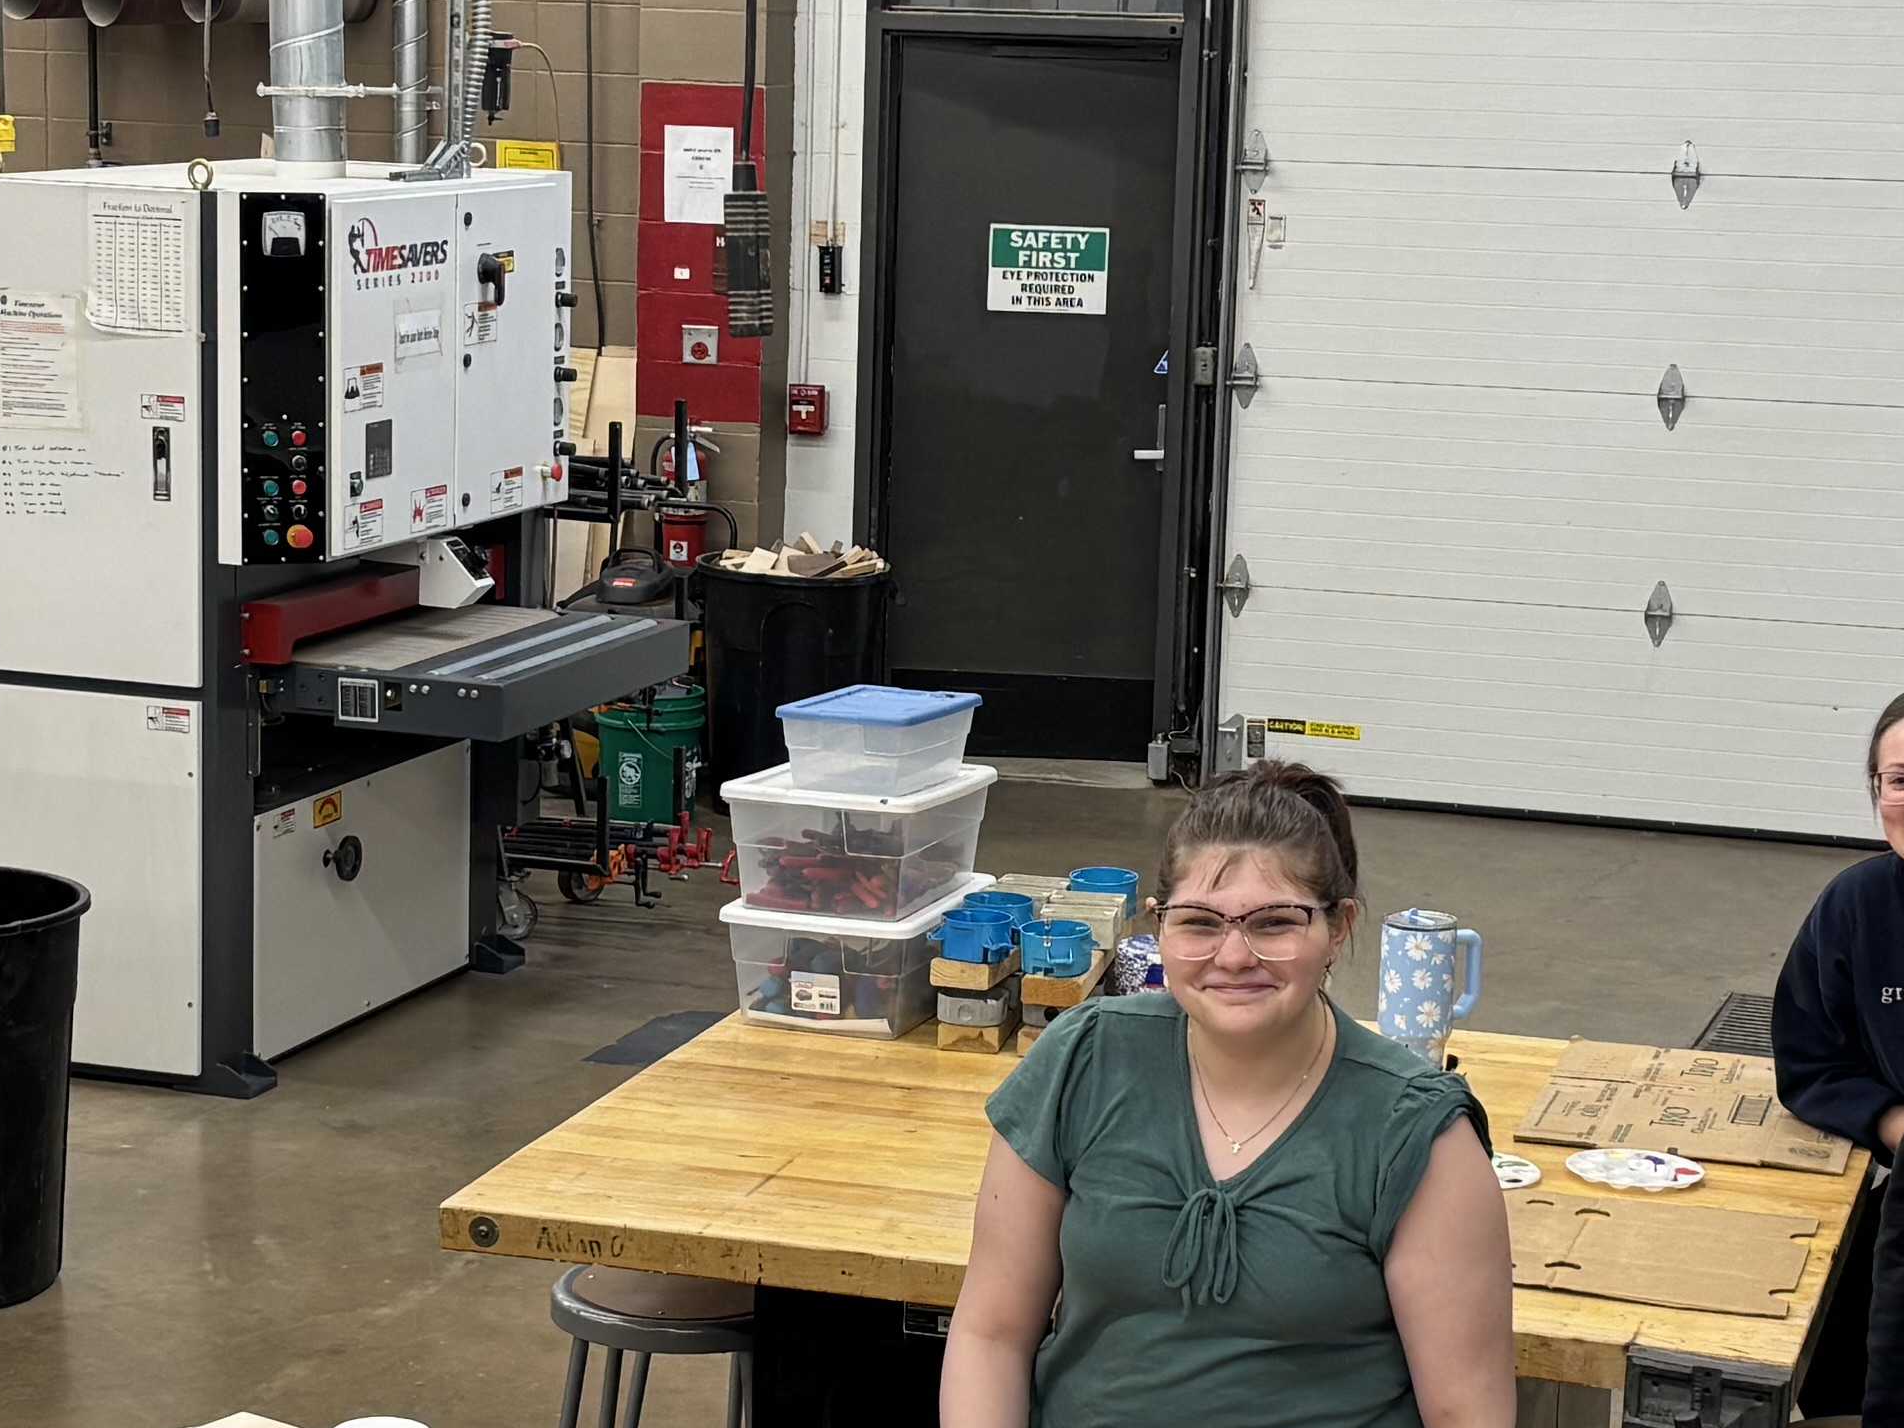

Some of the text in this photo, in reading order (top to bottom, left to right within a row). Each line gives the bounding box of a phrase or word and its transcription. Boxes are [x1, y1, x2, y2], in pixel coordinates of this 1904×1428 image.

[1010, 231, 1089, 249] SAFETY
[366, 240, 448, 273] TIMESAVERS
[1018, 251, 1080, 268] FIRST
[357, 274, 401, 290] SERIES
[1002, 270, 1094, 283] EYE PROTECTION
[1021, 283, 1075, 295] REQUIRED
[1012, 295, 1083, 307] IN THIS AREA
